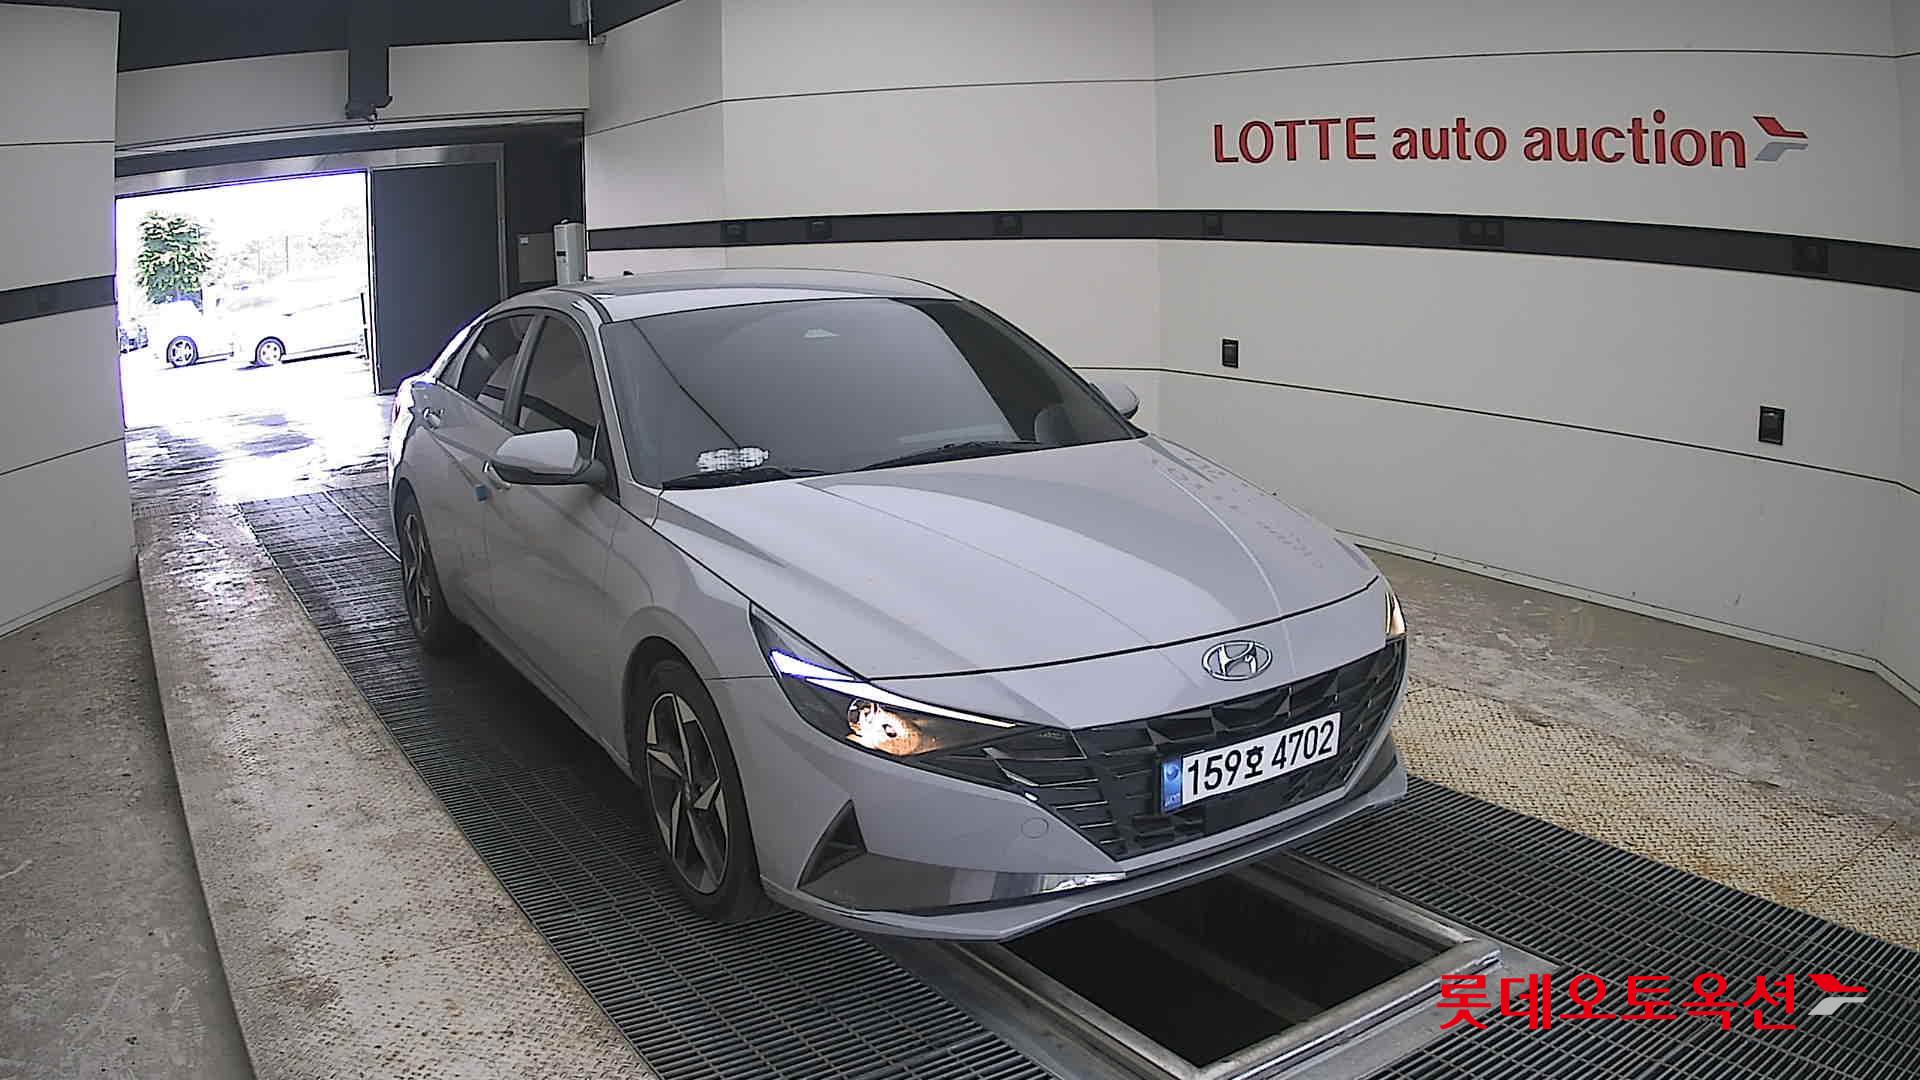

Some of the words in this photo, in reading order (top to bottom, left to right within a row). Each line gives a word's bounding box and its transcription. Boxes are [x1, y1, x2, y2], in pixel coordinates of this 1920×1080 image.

[1214, 117, 1377, 164] LOTTE
[1392, 117, 1507, 161] auto
[1523, 109, 1747, 169] auction
[1188, 746, 1264, 795] 159호
[1272, 721, 1334, 769] 4702
